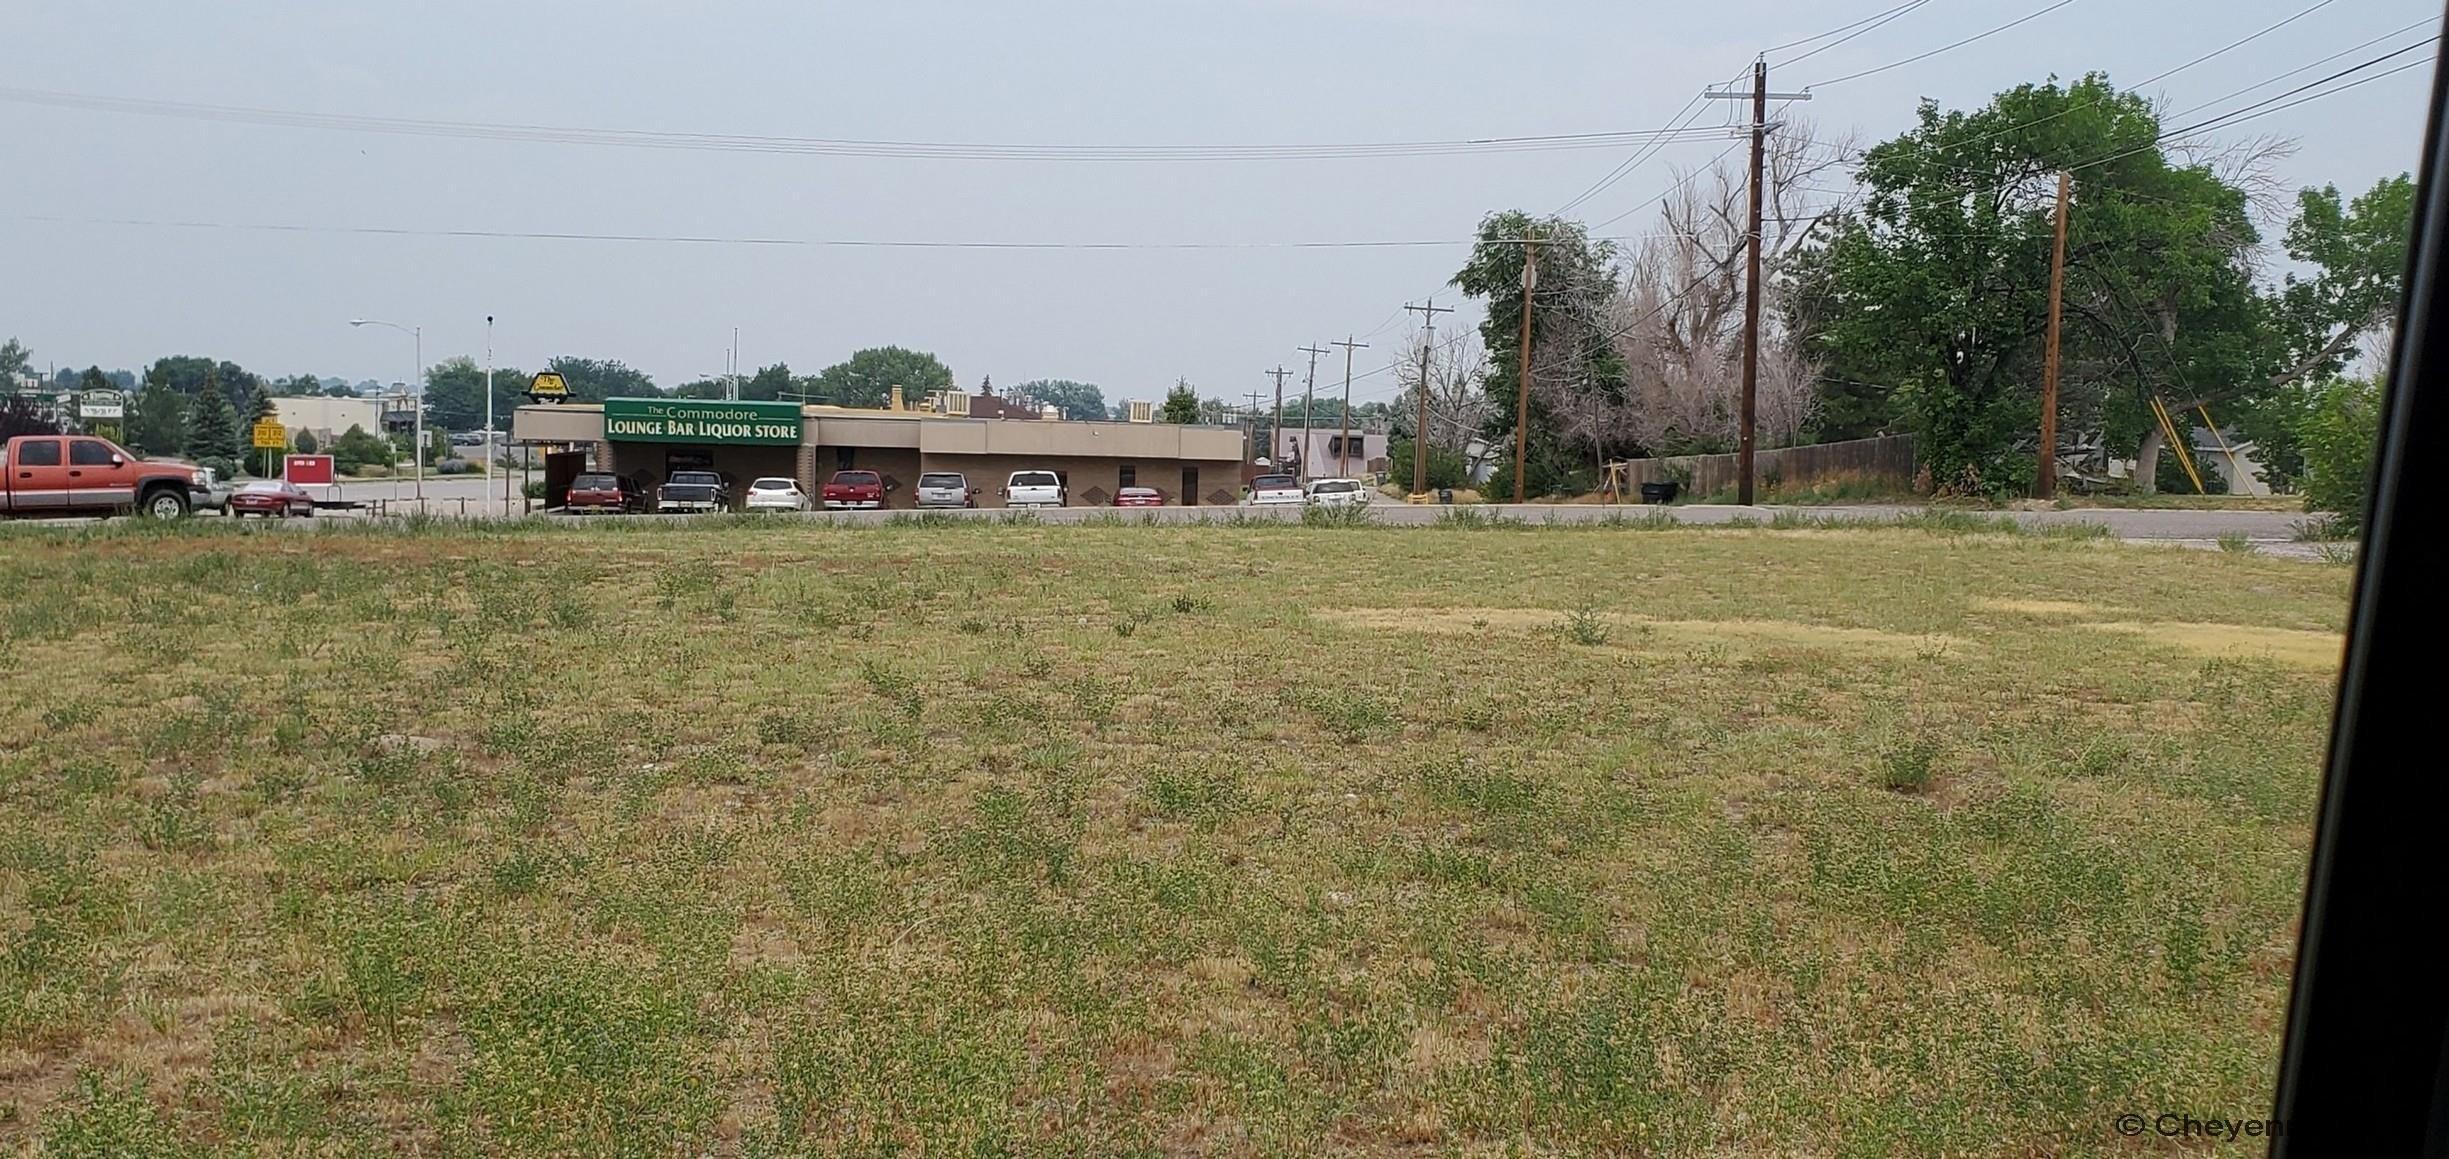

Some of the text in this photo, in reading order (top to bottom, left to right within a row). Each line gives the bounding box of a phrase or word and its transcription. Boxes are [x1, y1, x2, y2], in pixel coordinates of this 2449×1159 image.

[648, 406, 758, 421] The Commodore
[608, 418, 798, 439] LOUNGE BAR LIQUOR STORE
